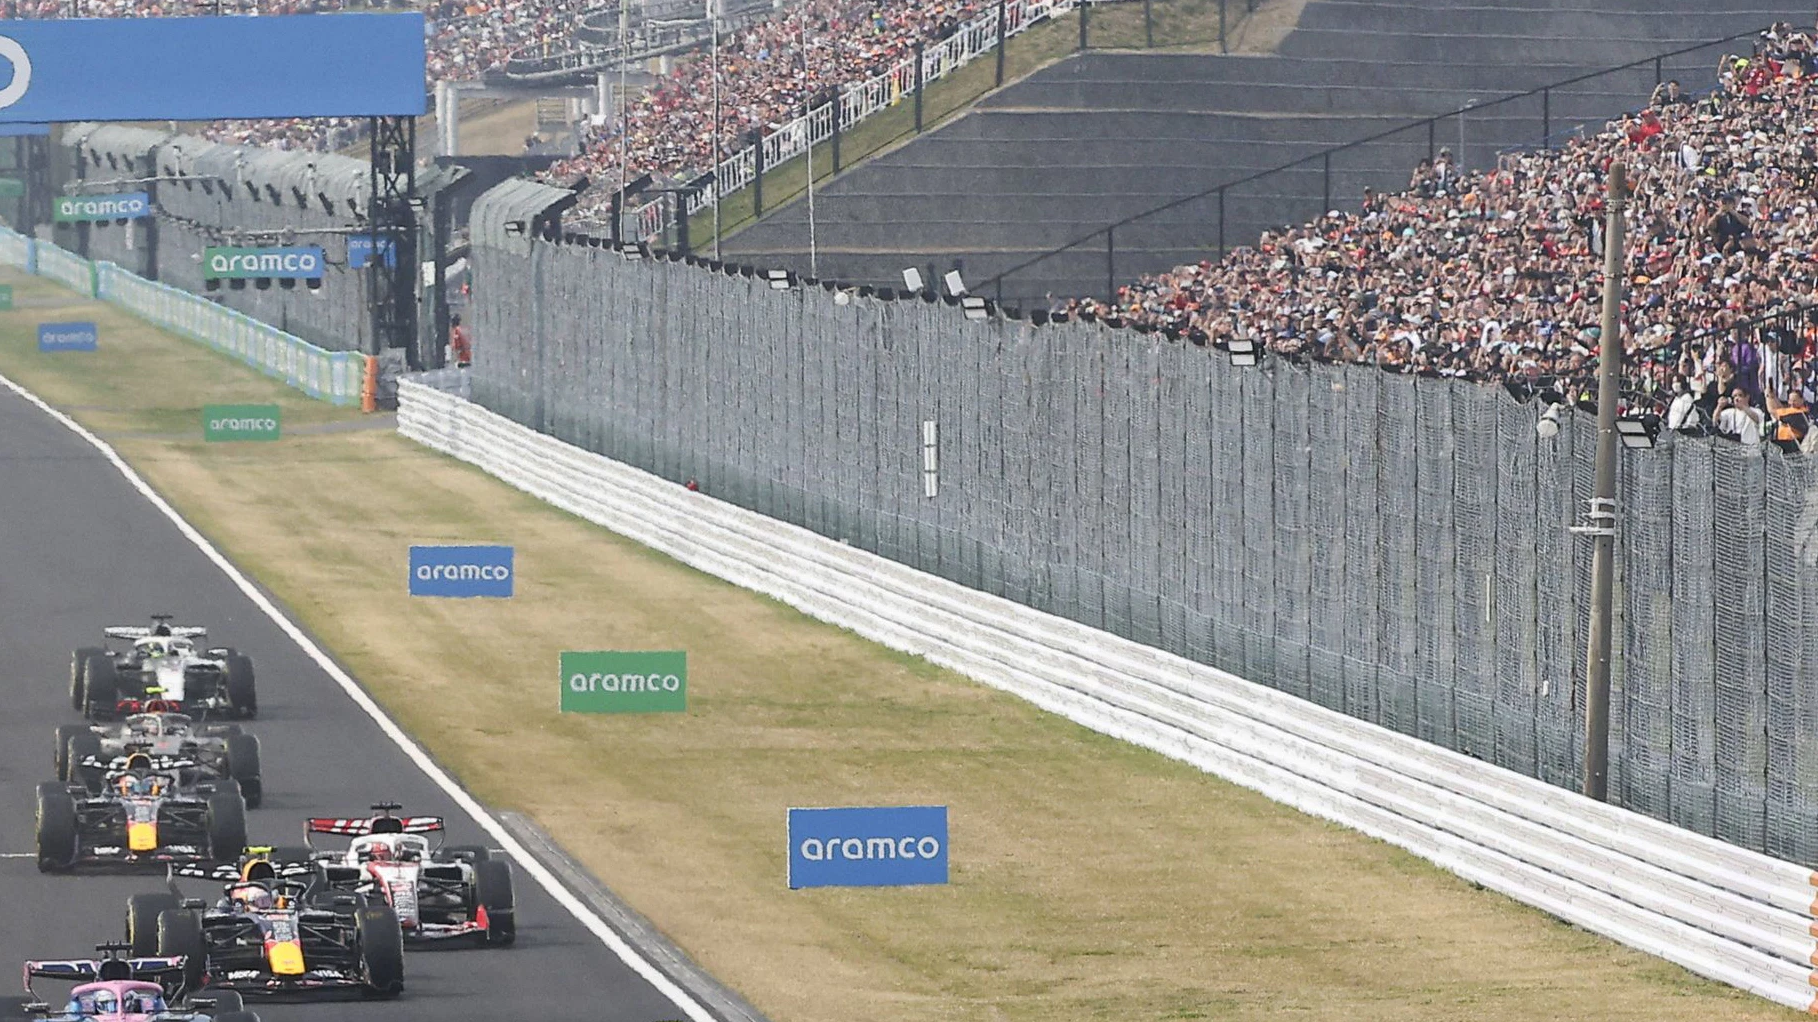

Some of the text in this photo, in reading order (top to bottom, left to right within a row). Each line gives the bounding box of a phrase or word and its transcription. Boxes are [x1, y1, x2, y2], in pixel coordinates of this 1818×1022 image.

[60, 198, 144, 216] aramco
[210, 252, 316, 272] aramco
[210, 418, 277, 431] aramco
[417, 563, 509, 581] aramco
[570, 673, 680, 693] aramco
[800, 836, 940, 861] aramco
